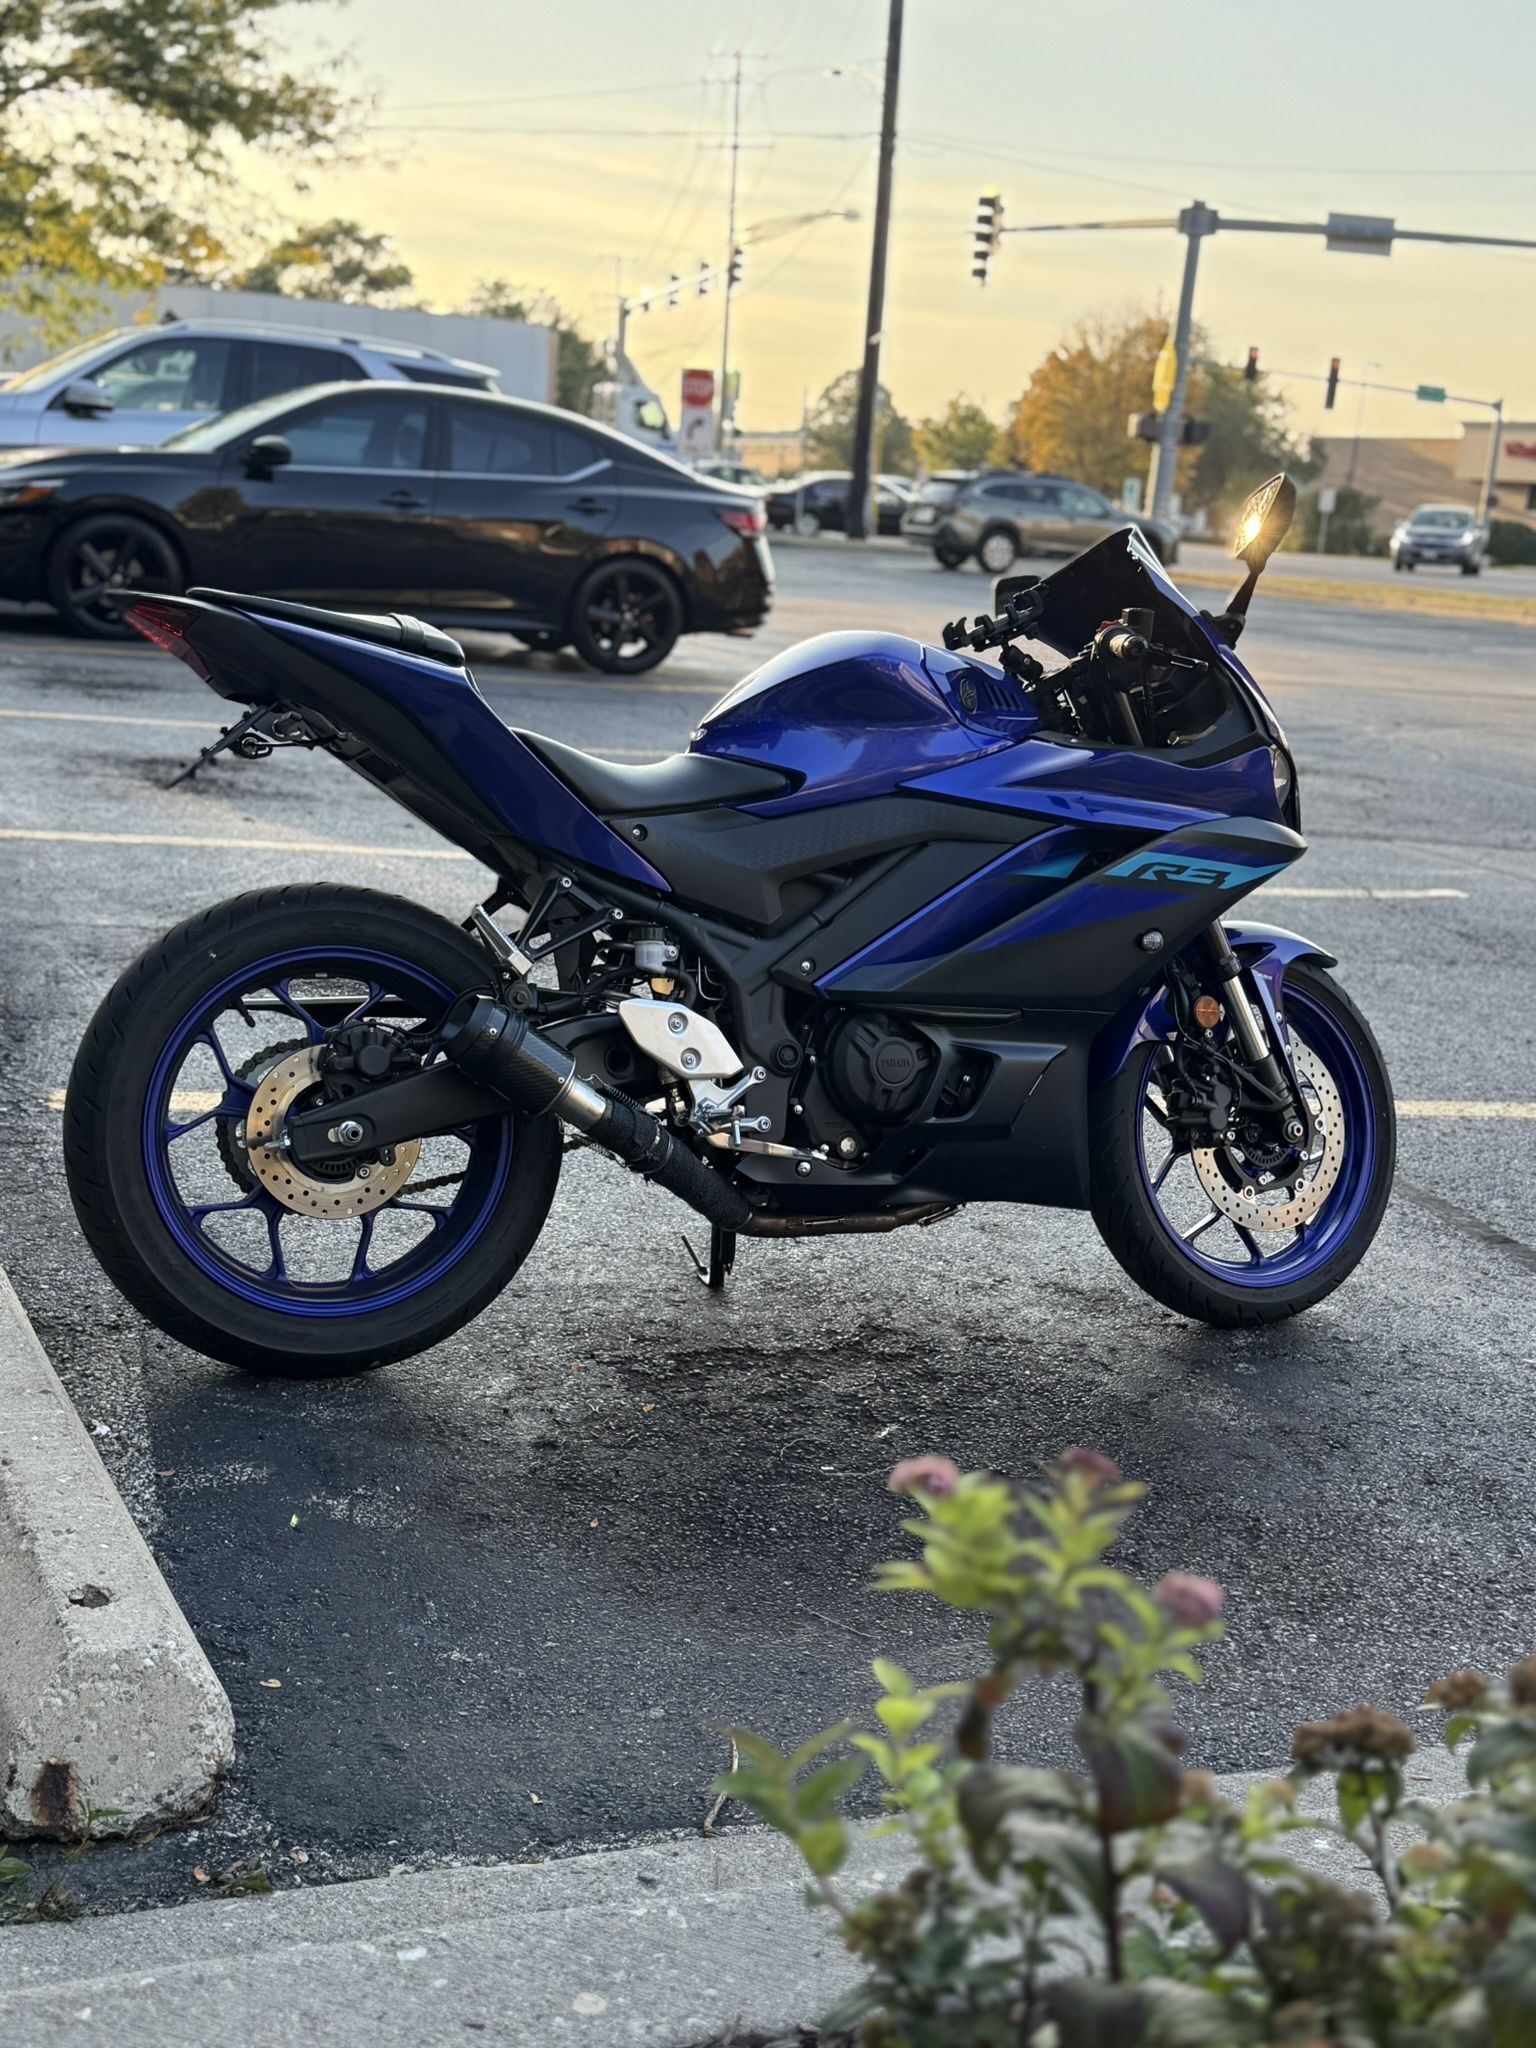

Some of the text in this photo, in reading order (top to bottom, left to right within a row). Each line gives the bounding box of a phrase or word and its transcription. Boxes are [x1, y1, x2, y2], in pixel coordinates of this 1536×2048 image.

[684, 379, 714, 395] STOP
[1127, 861, 1231, 888] R3
[880, 1058, 911, 1068] YAMAHA
